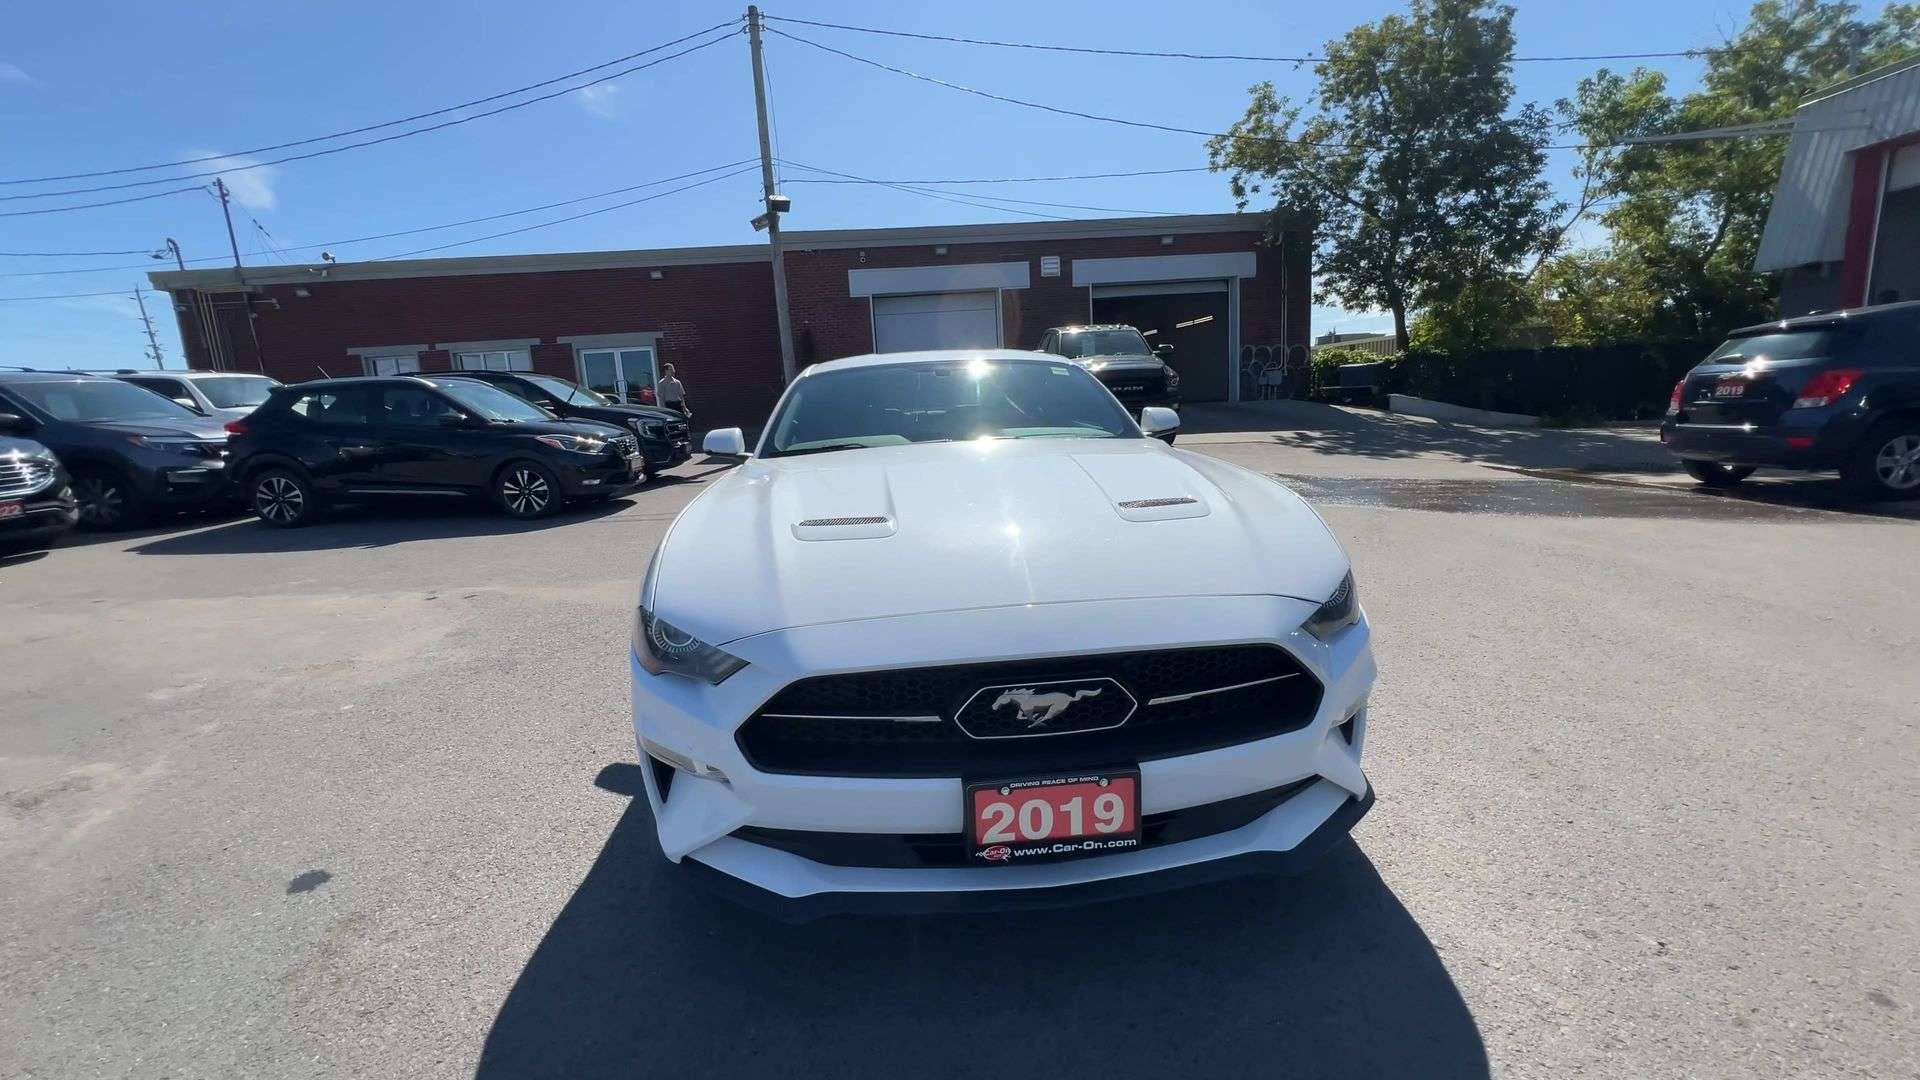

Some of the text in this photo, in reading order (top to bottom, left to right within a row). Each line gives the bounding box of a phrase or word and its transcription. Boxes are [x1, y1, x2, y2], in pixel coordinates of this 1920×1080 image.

[1715, 385, 1744, 396] 2019
[1010, 781, 1040, 789] DRIVING
[981, 793, 1125, 844] 2019
[1014, 839, 1137, 857] www.Car-On.com
